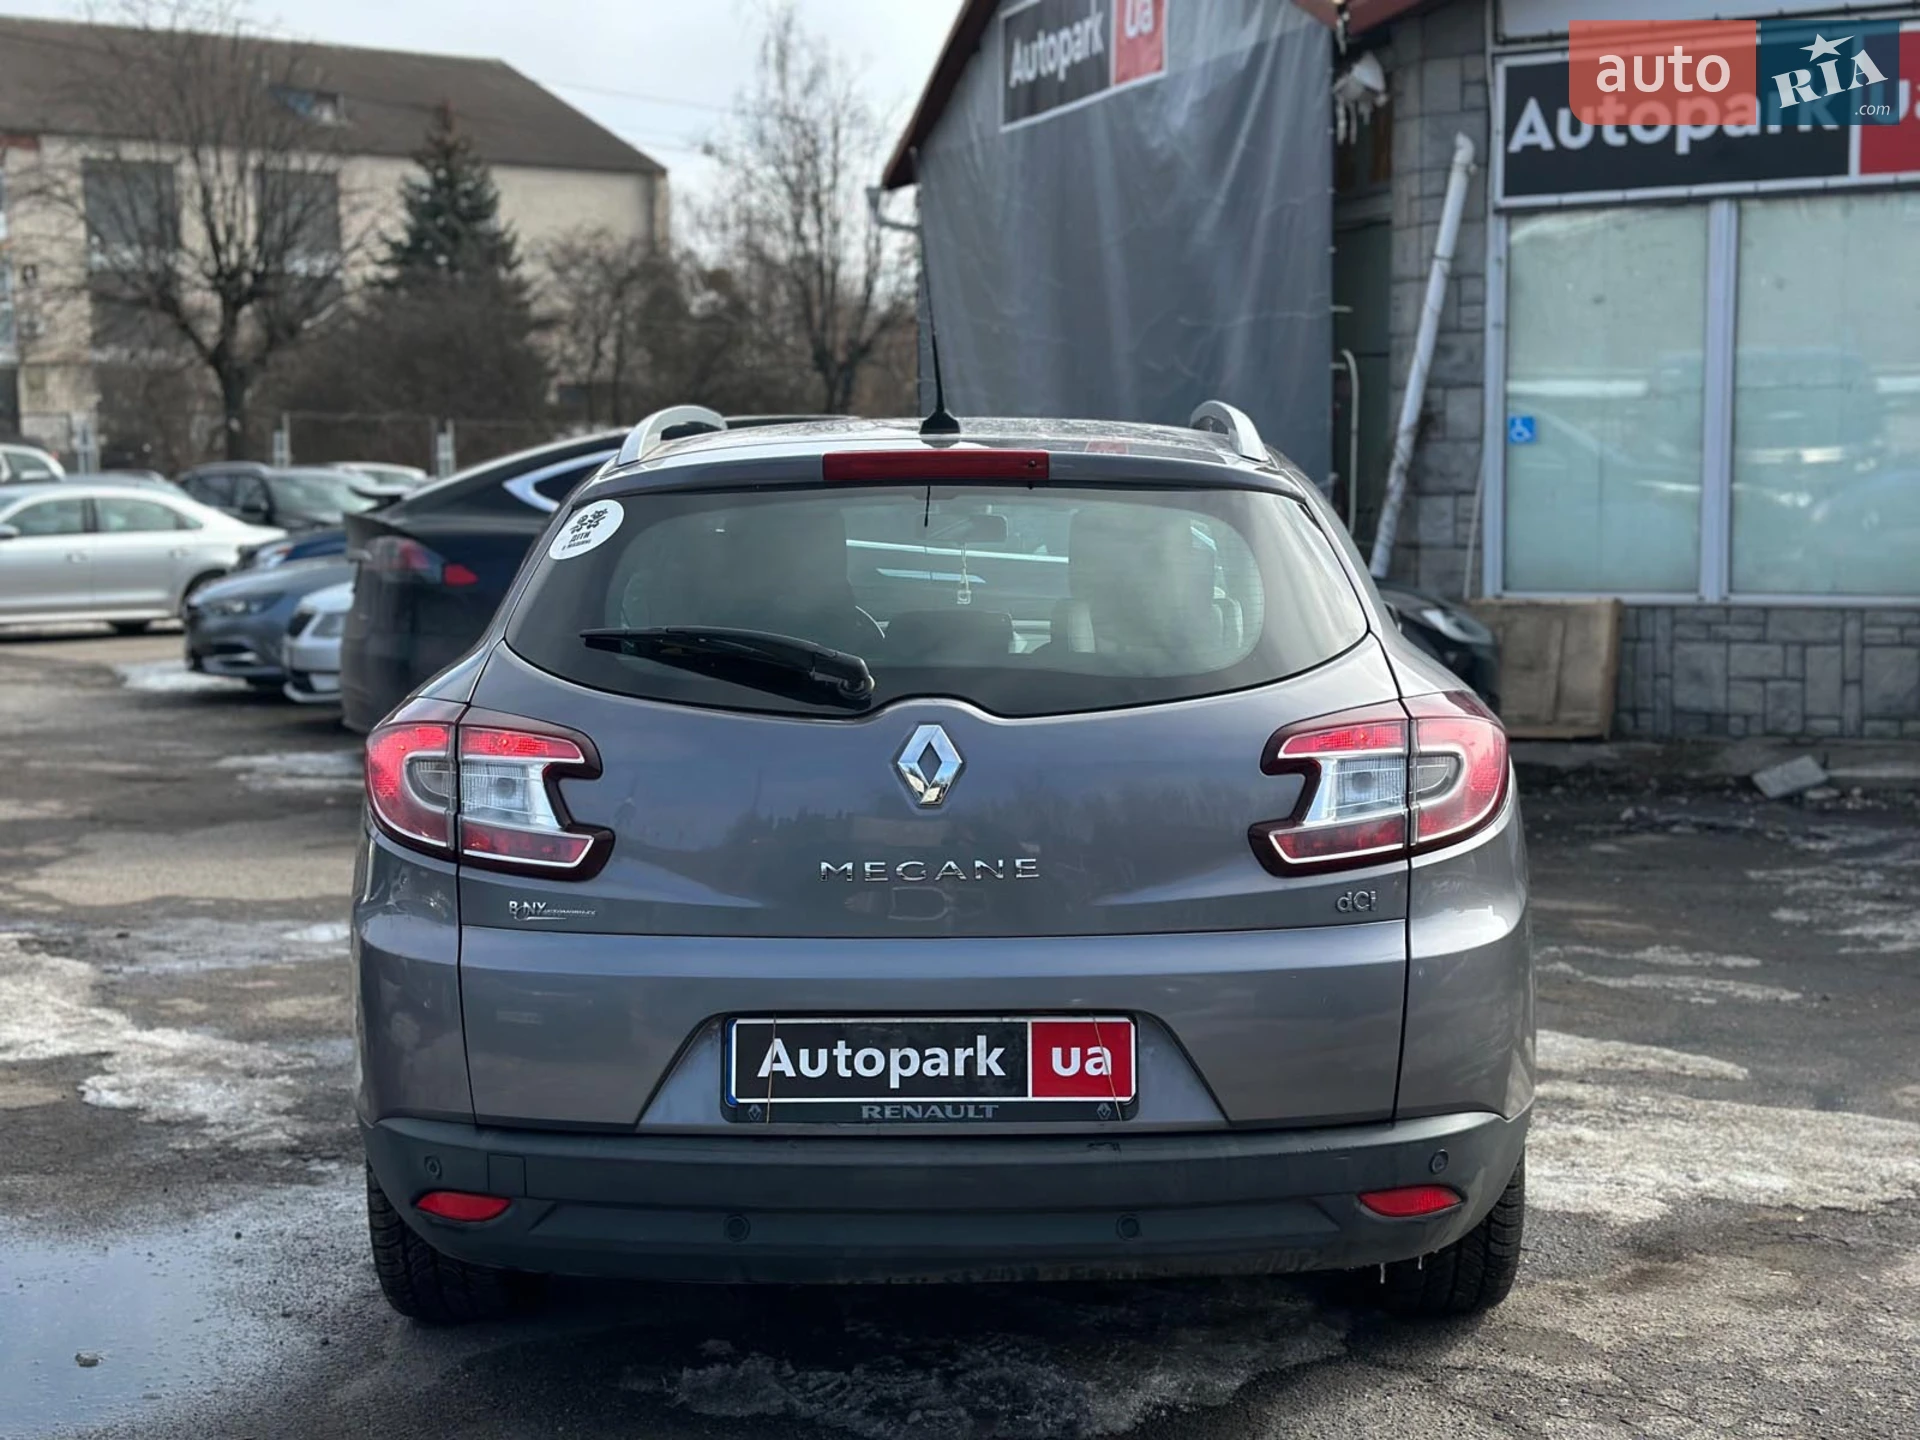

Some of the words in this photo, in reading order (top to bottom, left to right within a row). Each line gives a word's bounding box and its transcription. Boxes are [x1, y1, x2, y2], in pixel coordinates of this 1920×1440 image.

[1009, 0, 1104, 88] Autopark
[1507, 68, 1840, 155] Autopark
[819, 858, 1041, 882] MEGANE
[1336, 890, 1377, 912] dCi
[757, 1035, 1006, 1089] Autopark
[1051, 1045, 1112, 1076] ua
[861, 1104, 999, 1120] RENAULT
